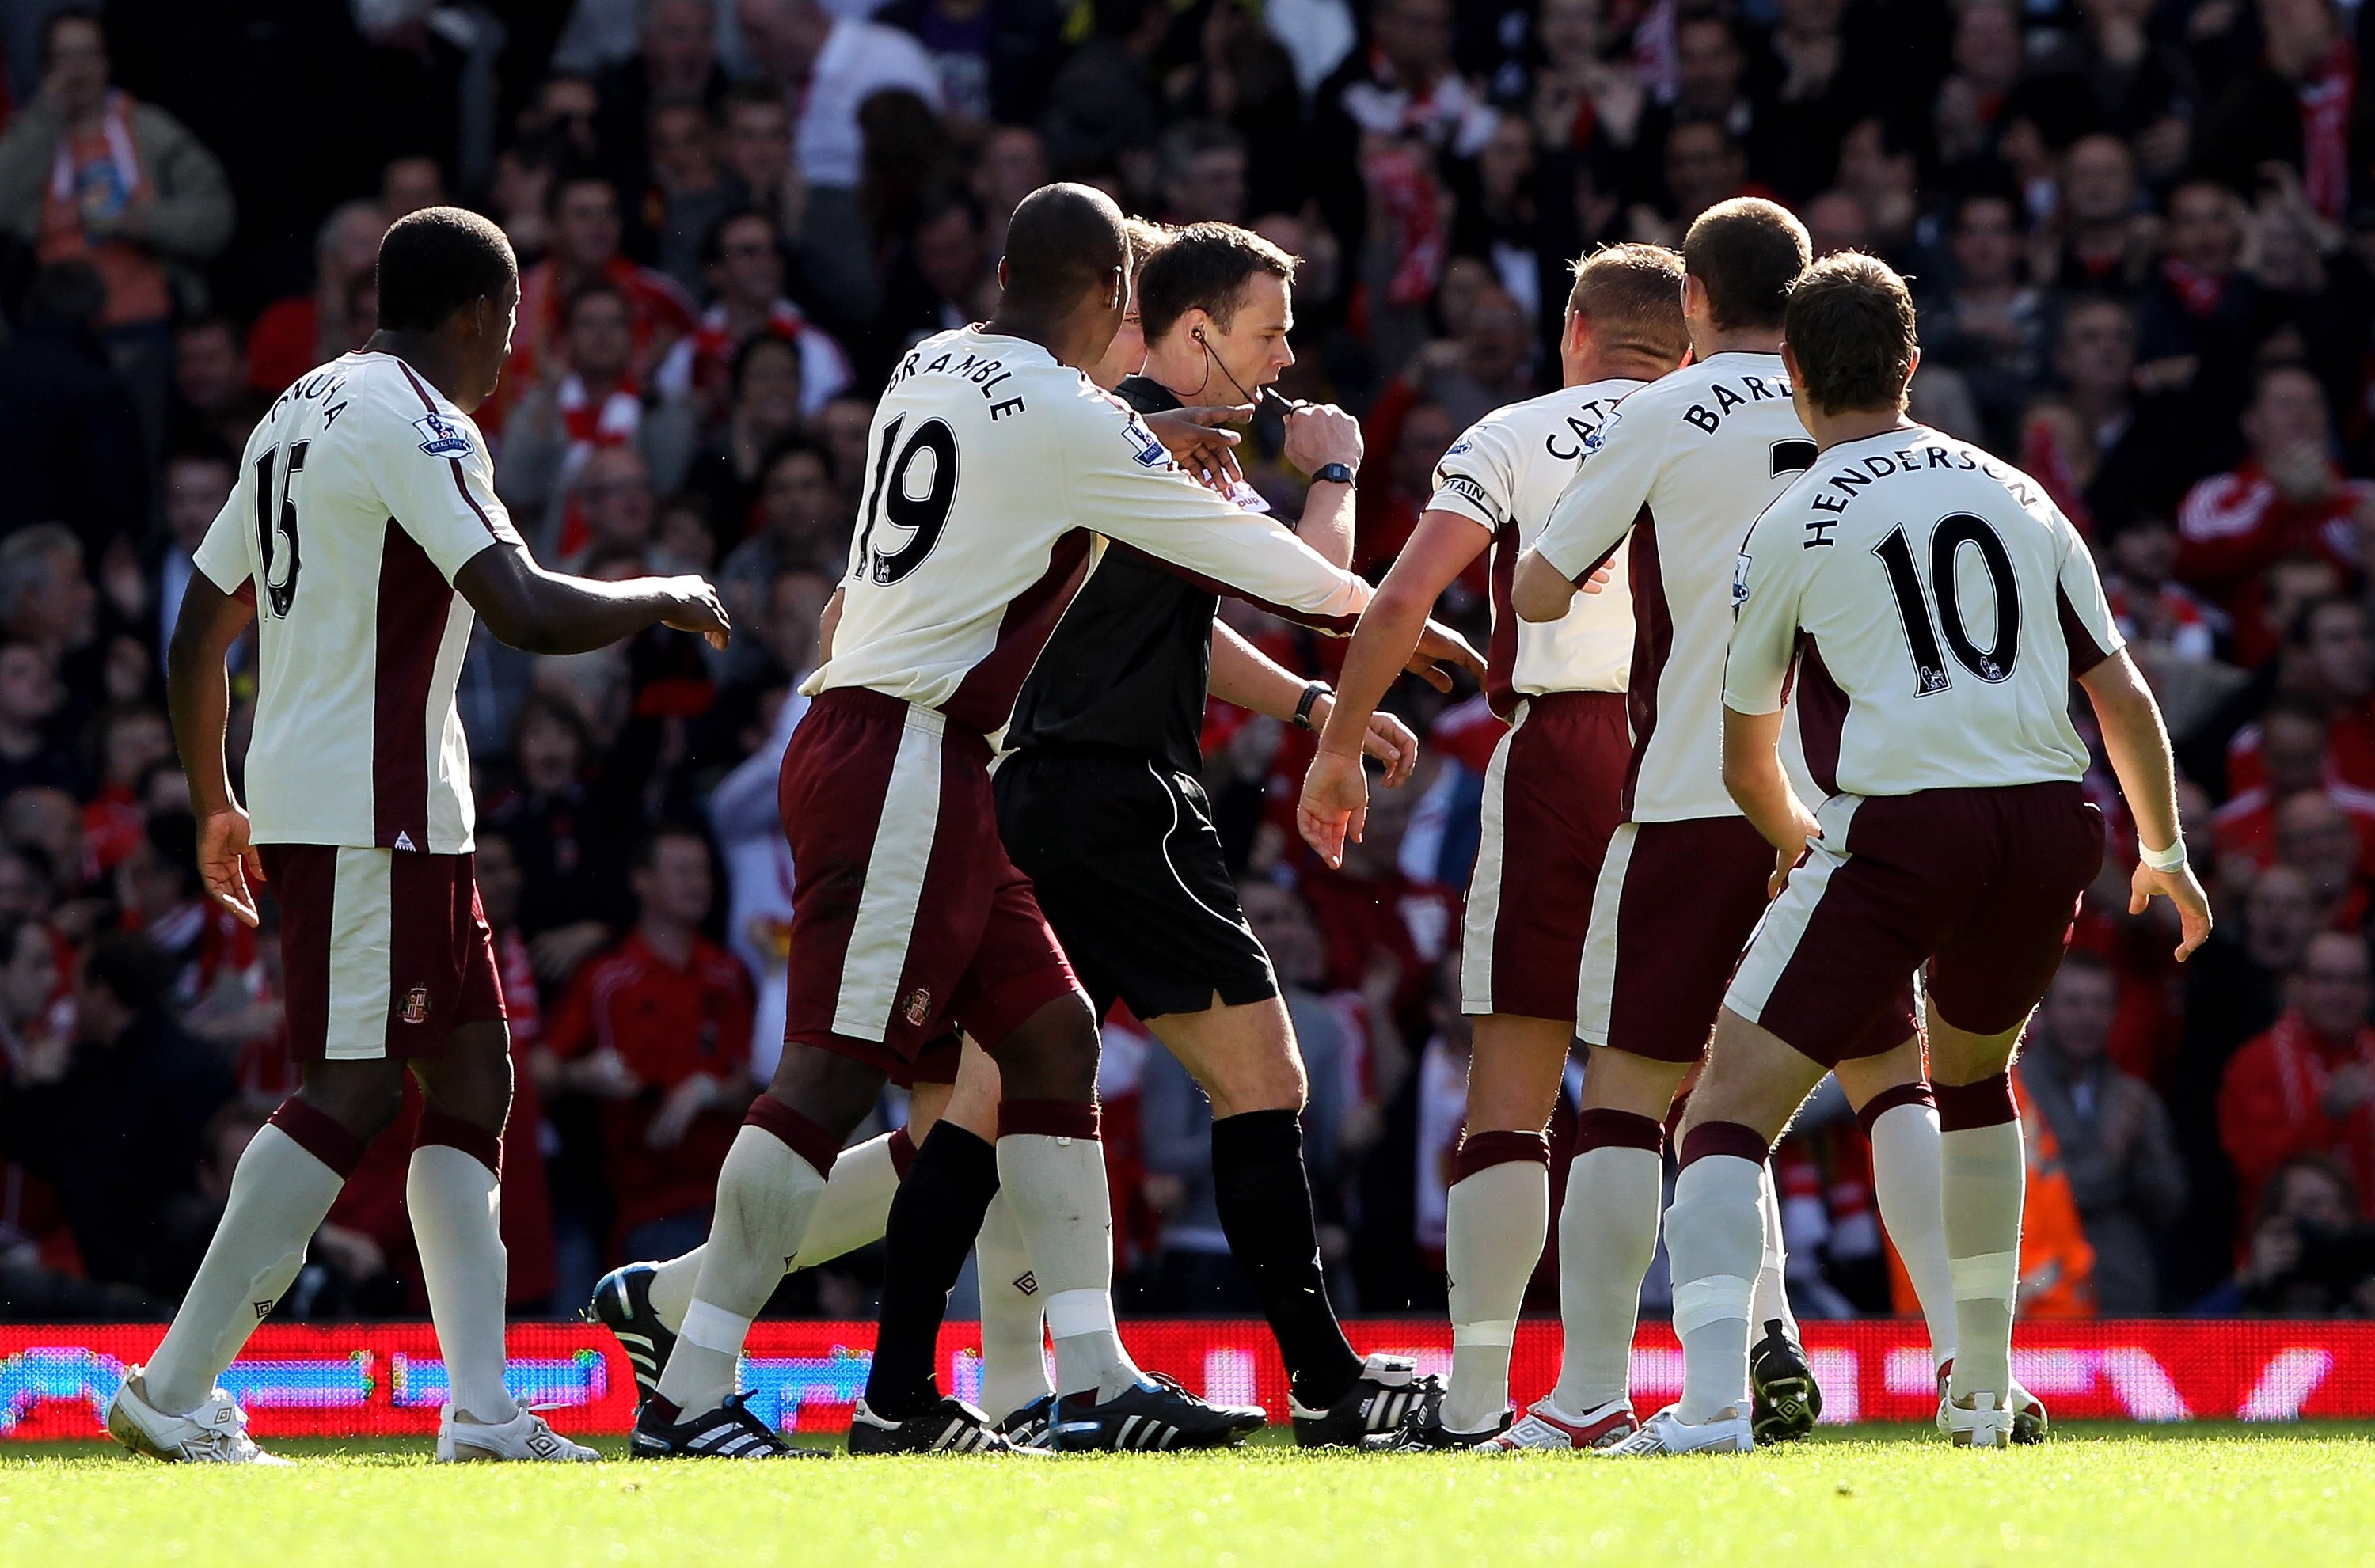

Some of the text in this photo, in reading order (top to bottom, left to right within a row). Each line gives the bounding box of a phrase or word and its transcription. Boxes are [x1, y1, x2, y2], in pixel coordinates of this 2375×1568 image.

[253, 439, 312, 620] 15
[853, 411, 960, 587] 19
[1803, 446, 2038, 549] HENDERSON
[1871, 511, 2023, 698] 10
